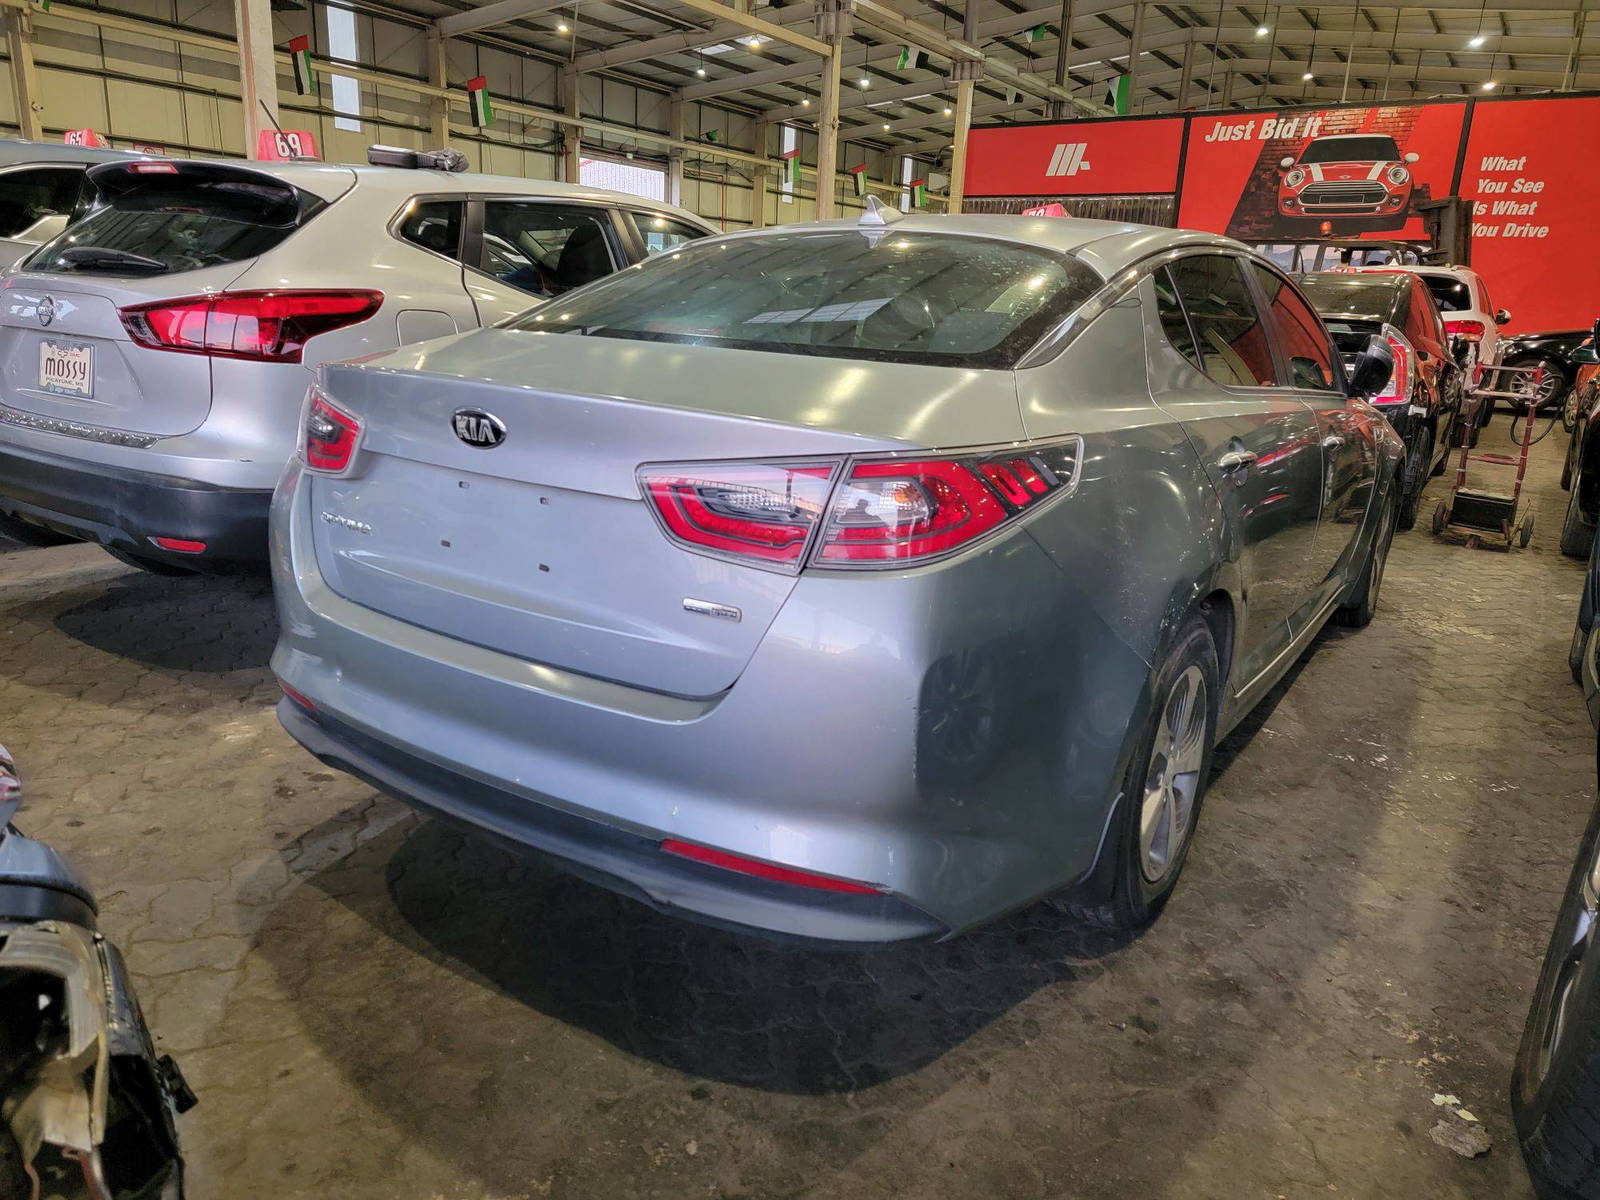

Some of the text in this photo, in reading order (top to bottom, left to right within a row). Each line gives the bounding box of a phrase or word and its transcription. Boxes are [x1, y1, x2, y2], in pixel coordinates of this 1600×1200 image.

[1204, 117, 1322, 142] Just Bid It
[69, 131, 83, 146] 65
[275, 132, 302, 158] 69
[1480, 156, 1527, 171] What
[1477, 178, 1545, 193] You See
[1472, 200, 1538, 216] Is What
[1471, 222, 1550, 238] You Drive
[45, 357, 87, 380] MOSSY
[455, 414, 497, 443] KIA
